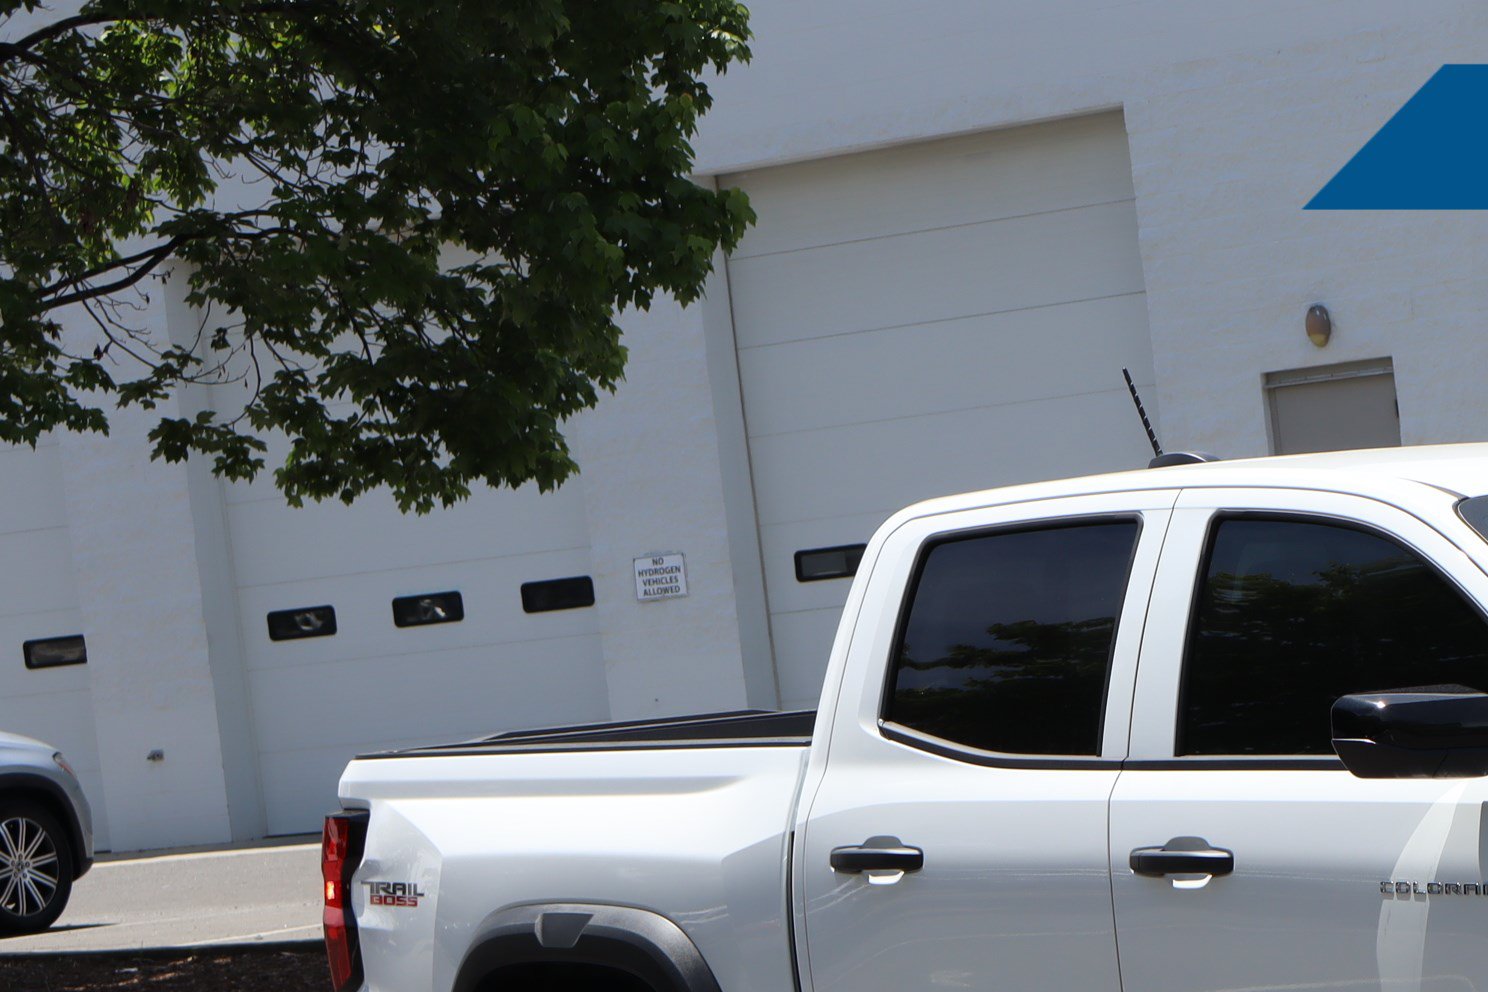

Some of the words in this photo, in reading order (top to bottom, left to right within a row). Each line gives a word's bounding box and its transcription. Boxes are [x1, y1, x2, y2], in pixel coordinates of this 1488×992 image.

[651, 557, 664, 566] NO
[638, 565, 681, 577] HYDROGEN
[642, 575, 679, 587] VEHICLES
[643, 585, 681, 597] ALLOWED
[360, 880, 424, 897] TRAIL
[369, 895, 418, 907] BOSS
